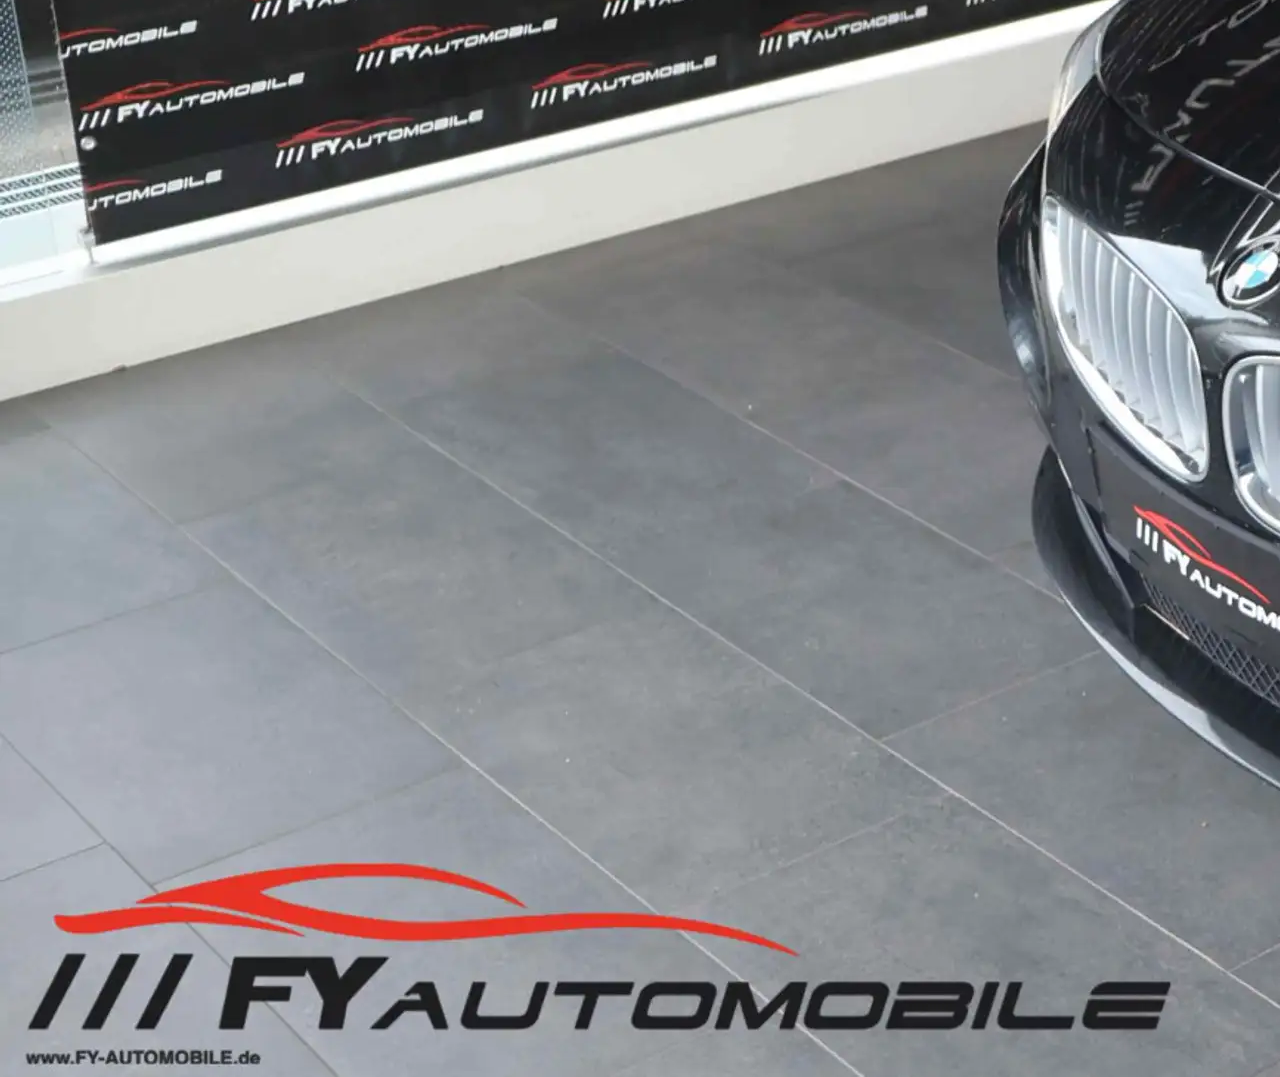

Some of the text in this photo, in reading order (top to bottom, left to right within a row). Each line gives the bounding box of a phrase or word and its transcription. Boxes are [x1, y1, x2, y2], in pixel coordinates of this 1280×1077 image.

[389, 17, 558, 65] FYAUTOMOBILE
[787, 5, 929, 50] FYAUTOMOBILE
[116, 71, 305, 123] FYAUTOMOBILE
[562, 54, 718, 104] FYAUTOMOBILE
[311, 108, 484, 163] FYAUTOMOBILE
